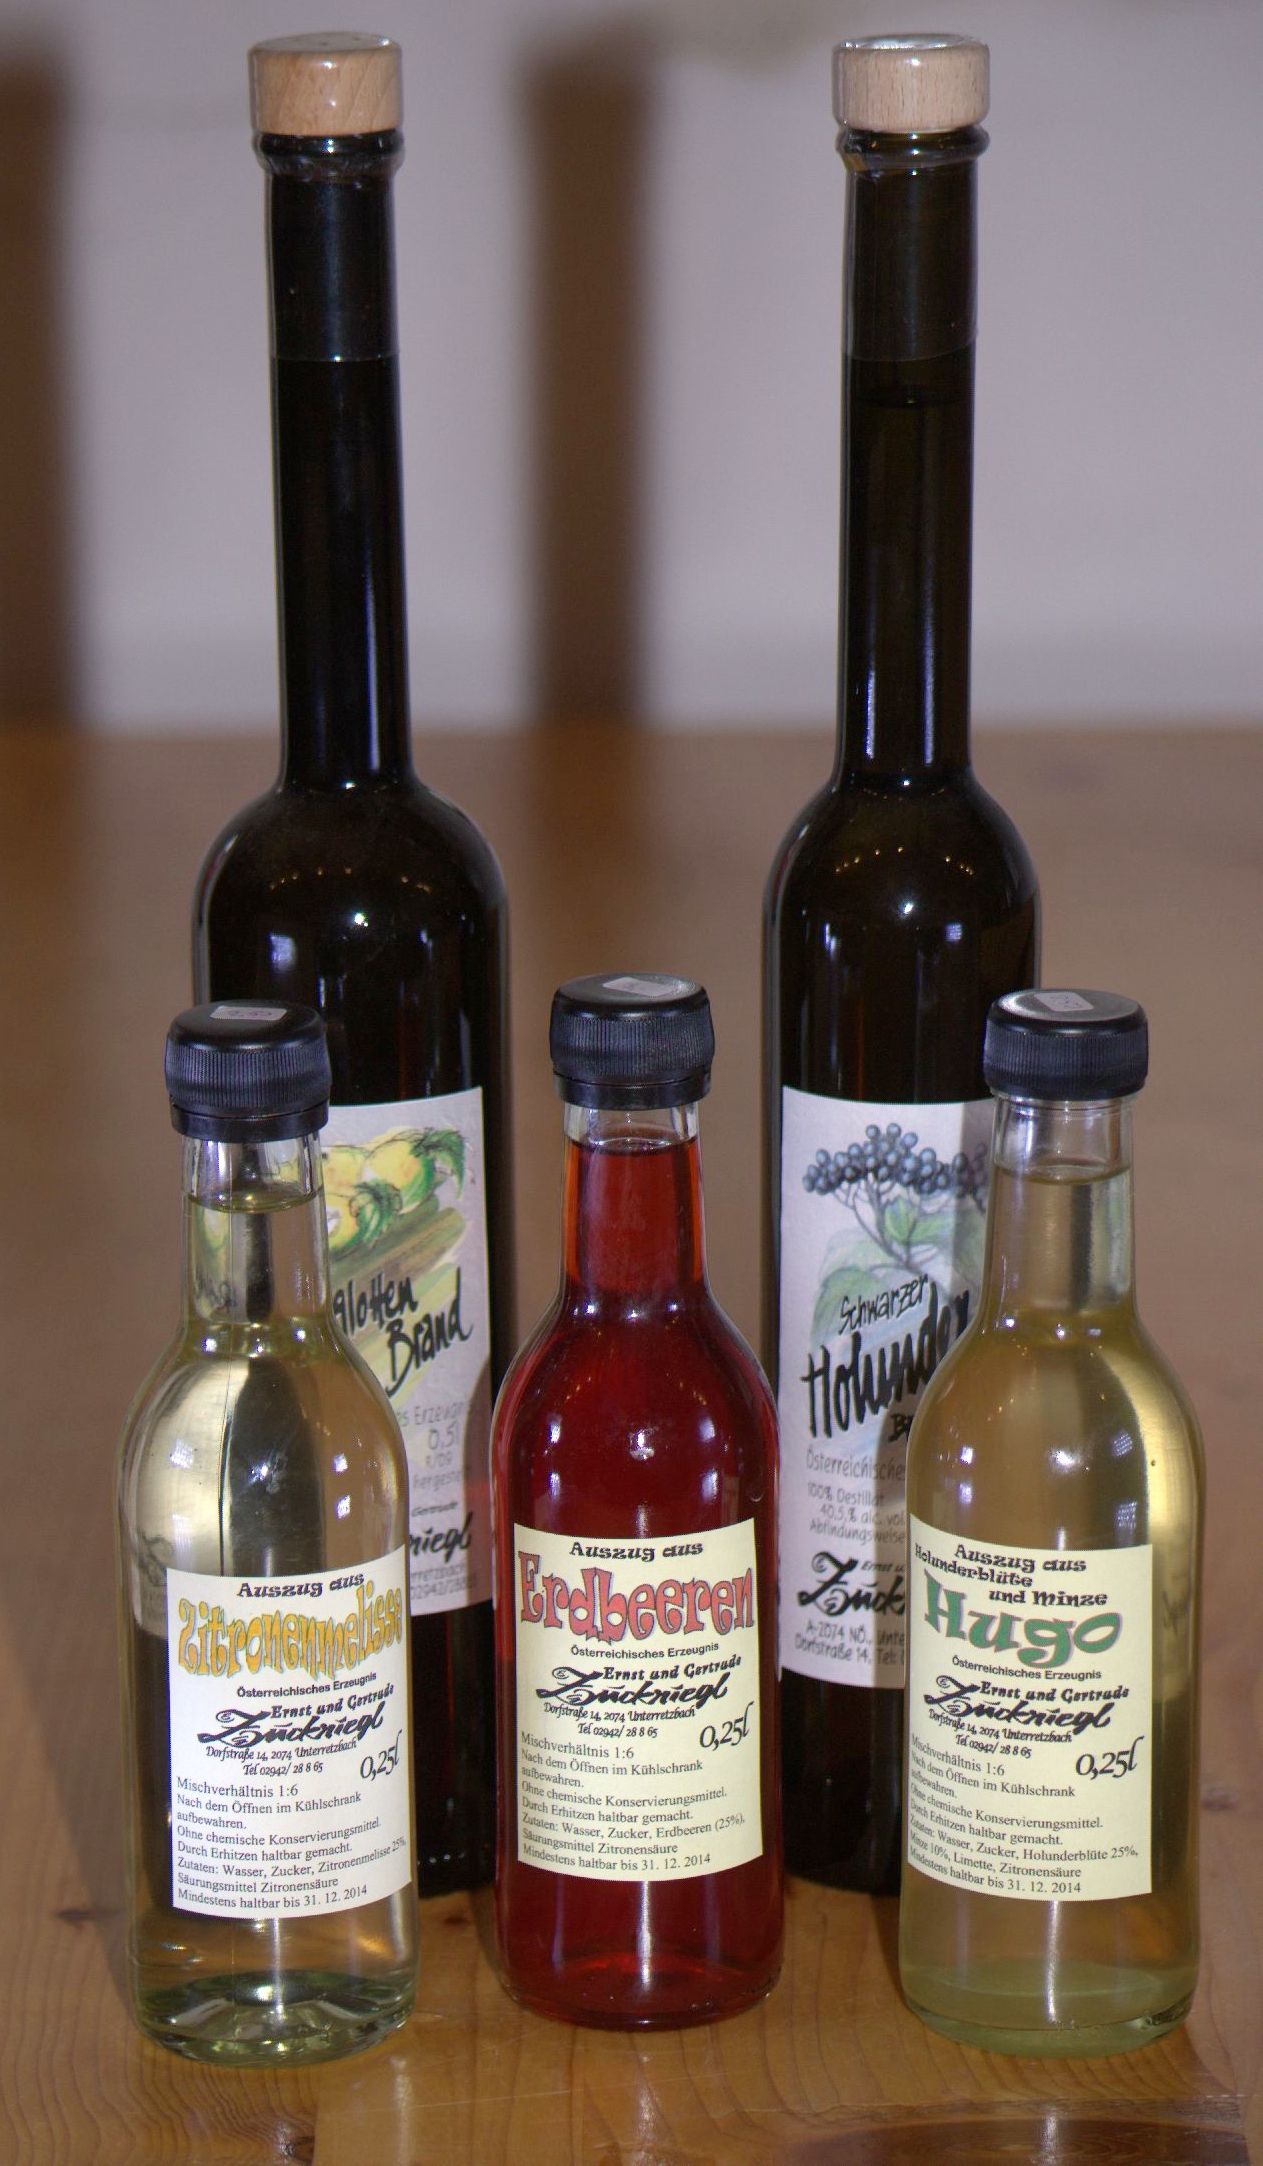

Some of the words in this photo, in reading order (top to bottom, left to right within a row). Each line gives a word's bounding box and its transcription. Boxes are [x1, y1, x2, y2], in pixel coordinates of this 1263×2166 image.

[838, 1274, 929, 1335] Schwarzer
[385, 1266, 474, 1398] Brand
[569, 1542, 655, 1562] Auszug
[662, 1543, 703, 1557] aus
[915, 1542, 1033, 1587] Holunderblüte
[954, 1544, 1035, 1574] Auszug
[1042, 1559, 1086, 1572] aus
[237, 1580, 324, 1598] Auszug
[329, 1573, 364, 1590] aus
[519, 1551, 754, 1645] Erdbeeren
[989, 1590, 1025, 1604] und
[1031, 1591, 1108, 1607] Minze
[924, 1569, 1122, 1669] Hugo
[571, 1645, 664, 1659] Österreichisches
[668, 1643, 719, 1658] Erzeugnis
[602, 1667, 645, 1680] Ernst
[650, 1669, 678, 1680] und
[684, 1654, 741, 1679] Gertrude
[952, 1655, 1041, 1679] Österreichisches
[1045, 1670, 1101, 1681] Erzeugnis
[237, 1682, 330, 1697] Österreichisches
[333, 1672, 376, 1690] Erzeugnis
[979, 1680, 1020, 1699] Ernst
[1025, 1688, 1056, 1702] und
[1061, 1686, 1129, 1703] Gertrude
[270, 1705, 312, 1719] Ernst
[317, 1700, 342, 1715] und
[348, 1683, 394, 1709] Gertrude
[544, 1702, 588, 1720] Dorfstraße
[603, 1712, 625, 1722] 2074
[629, 1708, 694, 1723] Unterretzbach
[578, 1724, 592, 1735] Tel
[626, 1727, 637, 1737] 28
[647, 1726, 658, 1738] 65
[700, 1702, 754, 1751] 0,25l
[928, 1708, 965, 1732] Dorfstraße
[979, 1726, 1000, 1739] 2074
[1003, 1727, 1072, 1743] Unterretzbach
[206, 1745, 254, 1762] Dorfstraße
[271, 1750, 292, 1760] 2074
[295, 1741, 357, 1757] Unterretzbach
[360, 1729, 402, 1781] 0,25l
[521, 1732, 609, 1758] Mischverhältnis
[615, 1747, 634, 1759] 1:6
[911, 1735, 981, 1772] Mischverhältnis
[987, 1762, 1005, 1775] 1:6
[955, 1734, 967, 1745] Tel
[1000, 1744, 1011, 1754] 28
[1020, 1746, 1032, 1759] 65
[1076, 1736, 1144, 1779] 0,25l
[243, 1764, 259, 1775] Tel
[293, 1764, 304, 1774] 28
[313, 1761, 323, 1773] 65
[521, 1750, 543, 1766] Nach
[546, 1756, 566, 1770] dem
[570, 1759, 609, 1774] Öffnen
[612, 1764, 628, 1774] im
[631, 1760, 703, 1776] Kühlschrank
[177, 1776, 273, 1798] Mischverhältnis
[279, 1785, 298, 1796] 1:6
[522, 1767, 584, 1789] aufbewahren.
[927, 1762, 944, 1776] dem
[946, 1768, 979, 1787] Öffnen
[983, 1779, 996, 1791] im
[1001, 1783, 1075, 1797] Kühlschrank
[177, 1794, 202, 1810] Nach
[205, 1801, 228, 1813] dem
[233, 1801, 272, 1814] Öffnen
[277, 1802, 291, 1813] im
[296, 1792, 361, 1812] Kühlschrank
[522, 1781, 544, 1798] Ohne
[546, 1789, 602, 1805] chemische
[605, 1787, 727, 1807] Konservierungsmittel.
[177, 1812, 247, 1829] aufbewahren.
[522, 1797, 549, 1813] Durch
[551, 1807, 595, 1821] Erhitzen
[598, 1810, 638, 1822] haltbar
[642, 1810, 693, 1825] gemacht.
[927, 1792, 972, 1818] chemische
[976, 1810, 1103, 1831] Konservierungsmittel.
[177, 1825, 203, 1840] Ohne
[206, 1832, 265, 1846] chemische
[270, 1817, 380, 1846] Konservierungsmittel.
[522, 1813, 558, 1832] Zutaten:
[562, 1823, 604, 1839] Wasser,
[608, 1827, 652, 1839] Zucker,
[656, 1823, 712, 1838] Erdbeeren
[930, 1811, 965, 1831] Erhitzen
[969, 1825, 1005, 1841] haltbar
[1010, 1833, 1063, 1846] gemacht.
[178, 1842, 207, 1857] Durch
[211, 1849, 258, 1861] Erhitzen
[262, 1849, 302, 1861] haltbar
[306, 1843, 352, 1860] gemacht.
[522, 1828, 594, 1852] Säurungsmittel
[598, 1844, 678, 1854] Zitronensäure
[938, 1829, 973, 1850] Wasser,
[977, 1842, 1019, 1859] Zucker,
[1023, 1848, 1108, 1861] Holunderblüte
[178, 1857, 219, 1874] Zutaten:
[223, 1865, 267, 1878] Wasser,
[271, 1865, 314, 1877] Zucker,
[318, 1847, 391, 1873] Zitronenmelisse
[523, 1843, 575, 1866] Mindestens
[579, 1856, 617, 1870] haltbar
[621, 1859, 638, 1870] bis
[642, 1860, 659, 1870] 31.
[664, 1858, 681, 1869] 12.
[684, 1853, 711, 1867] 2014
[930, 1842, 950, 1861] 10%,
[953, 1851, 995, 1873] Limette,
[1000, 1862, 1081, 1878] Zitronensäure
[178, 1873, 256, 1893] Säurungsmittel
[261, 1878, 338, 1893] Zitronensäure
[950, 1868, 983, 1885] haltbar
[987, 1877, 1004, 1889] bis
[1007, 1880, 1024, 1891] 31.
[1031, 1882, 1047, 1892] 12.
[1052, 1883, 1081, 1893] 2014
[178, 1889, 236, 1907] Mindestens
[240, 1898, 279, 1909] haltbar
[284, 1896, 300, 1908] bis
[304, 1895, 320, 1906] 31.
[326, 1892, 341, 1904] 12.
[344, 1885, 367, 1899] 2014
